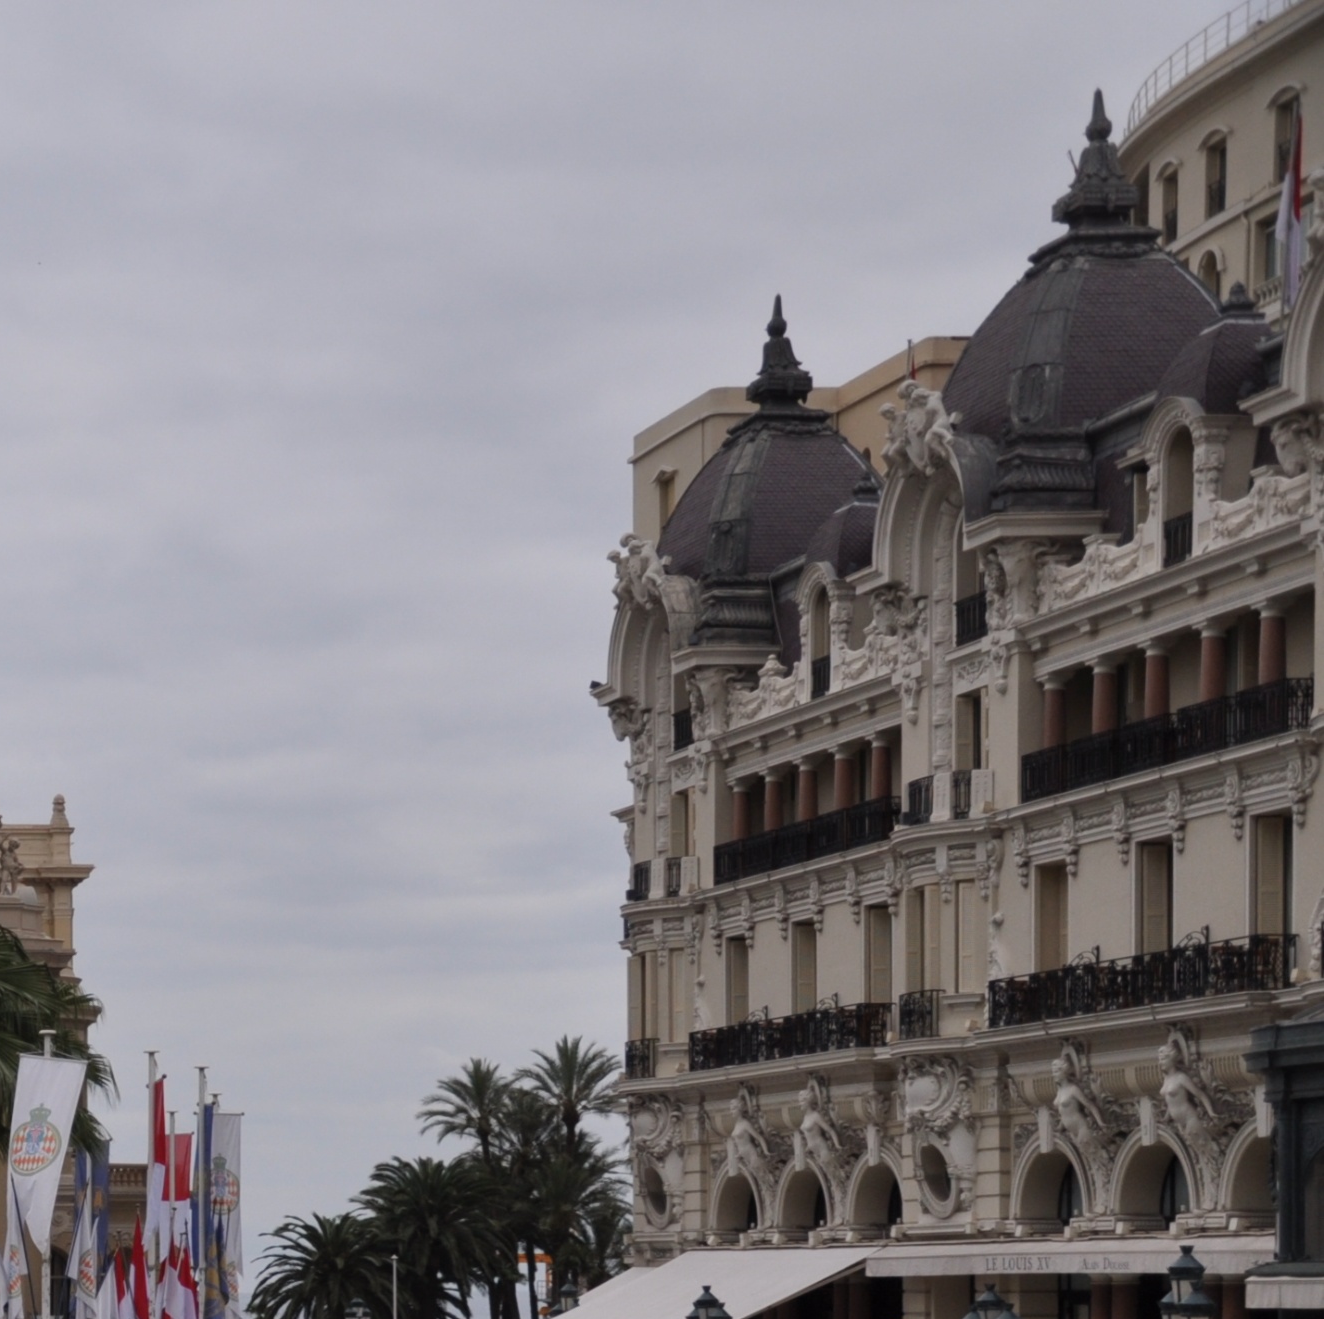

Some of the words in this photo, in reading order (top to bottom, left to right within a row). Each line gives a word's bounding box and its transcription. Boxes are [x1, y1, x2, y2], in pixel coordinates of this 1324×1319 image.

[985, 1258, 998, 1271] LE
[1002, 1257, 1033, 1271] LOUIS
[1037, 1257, 1051, 1271] XV
